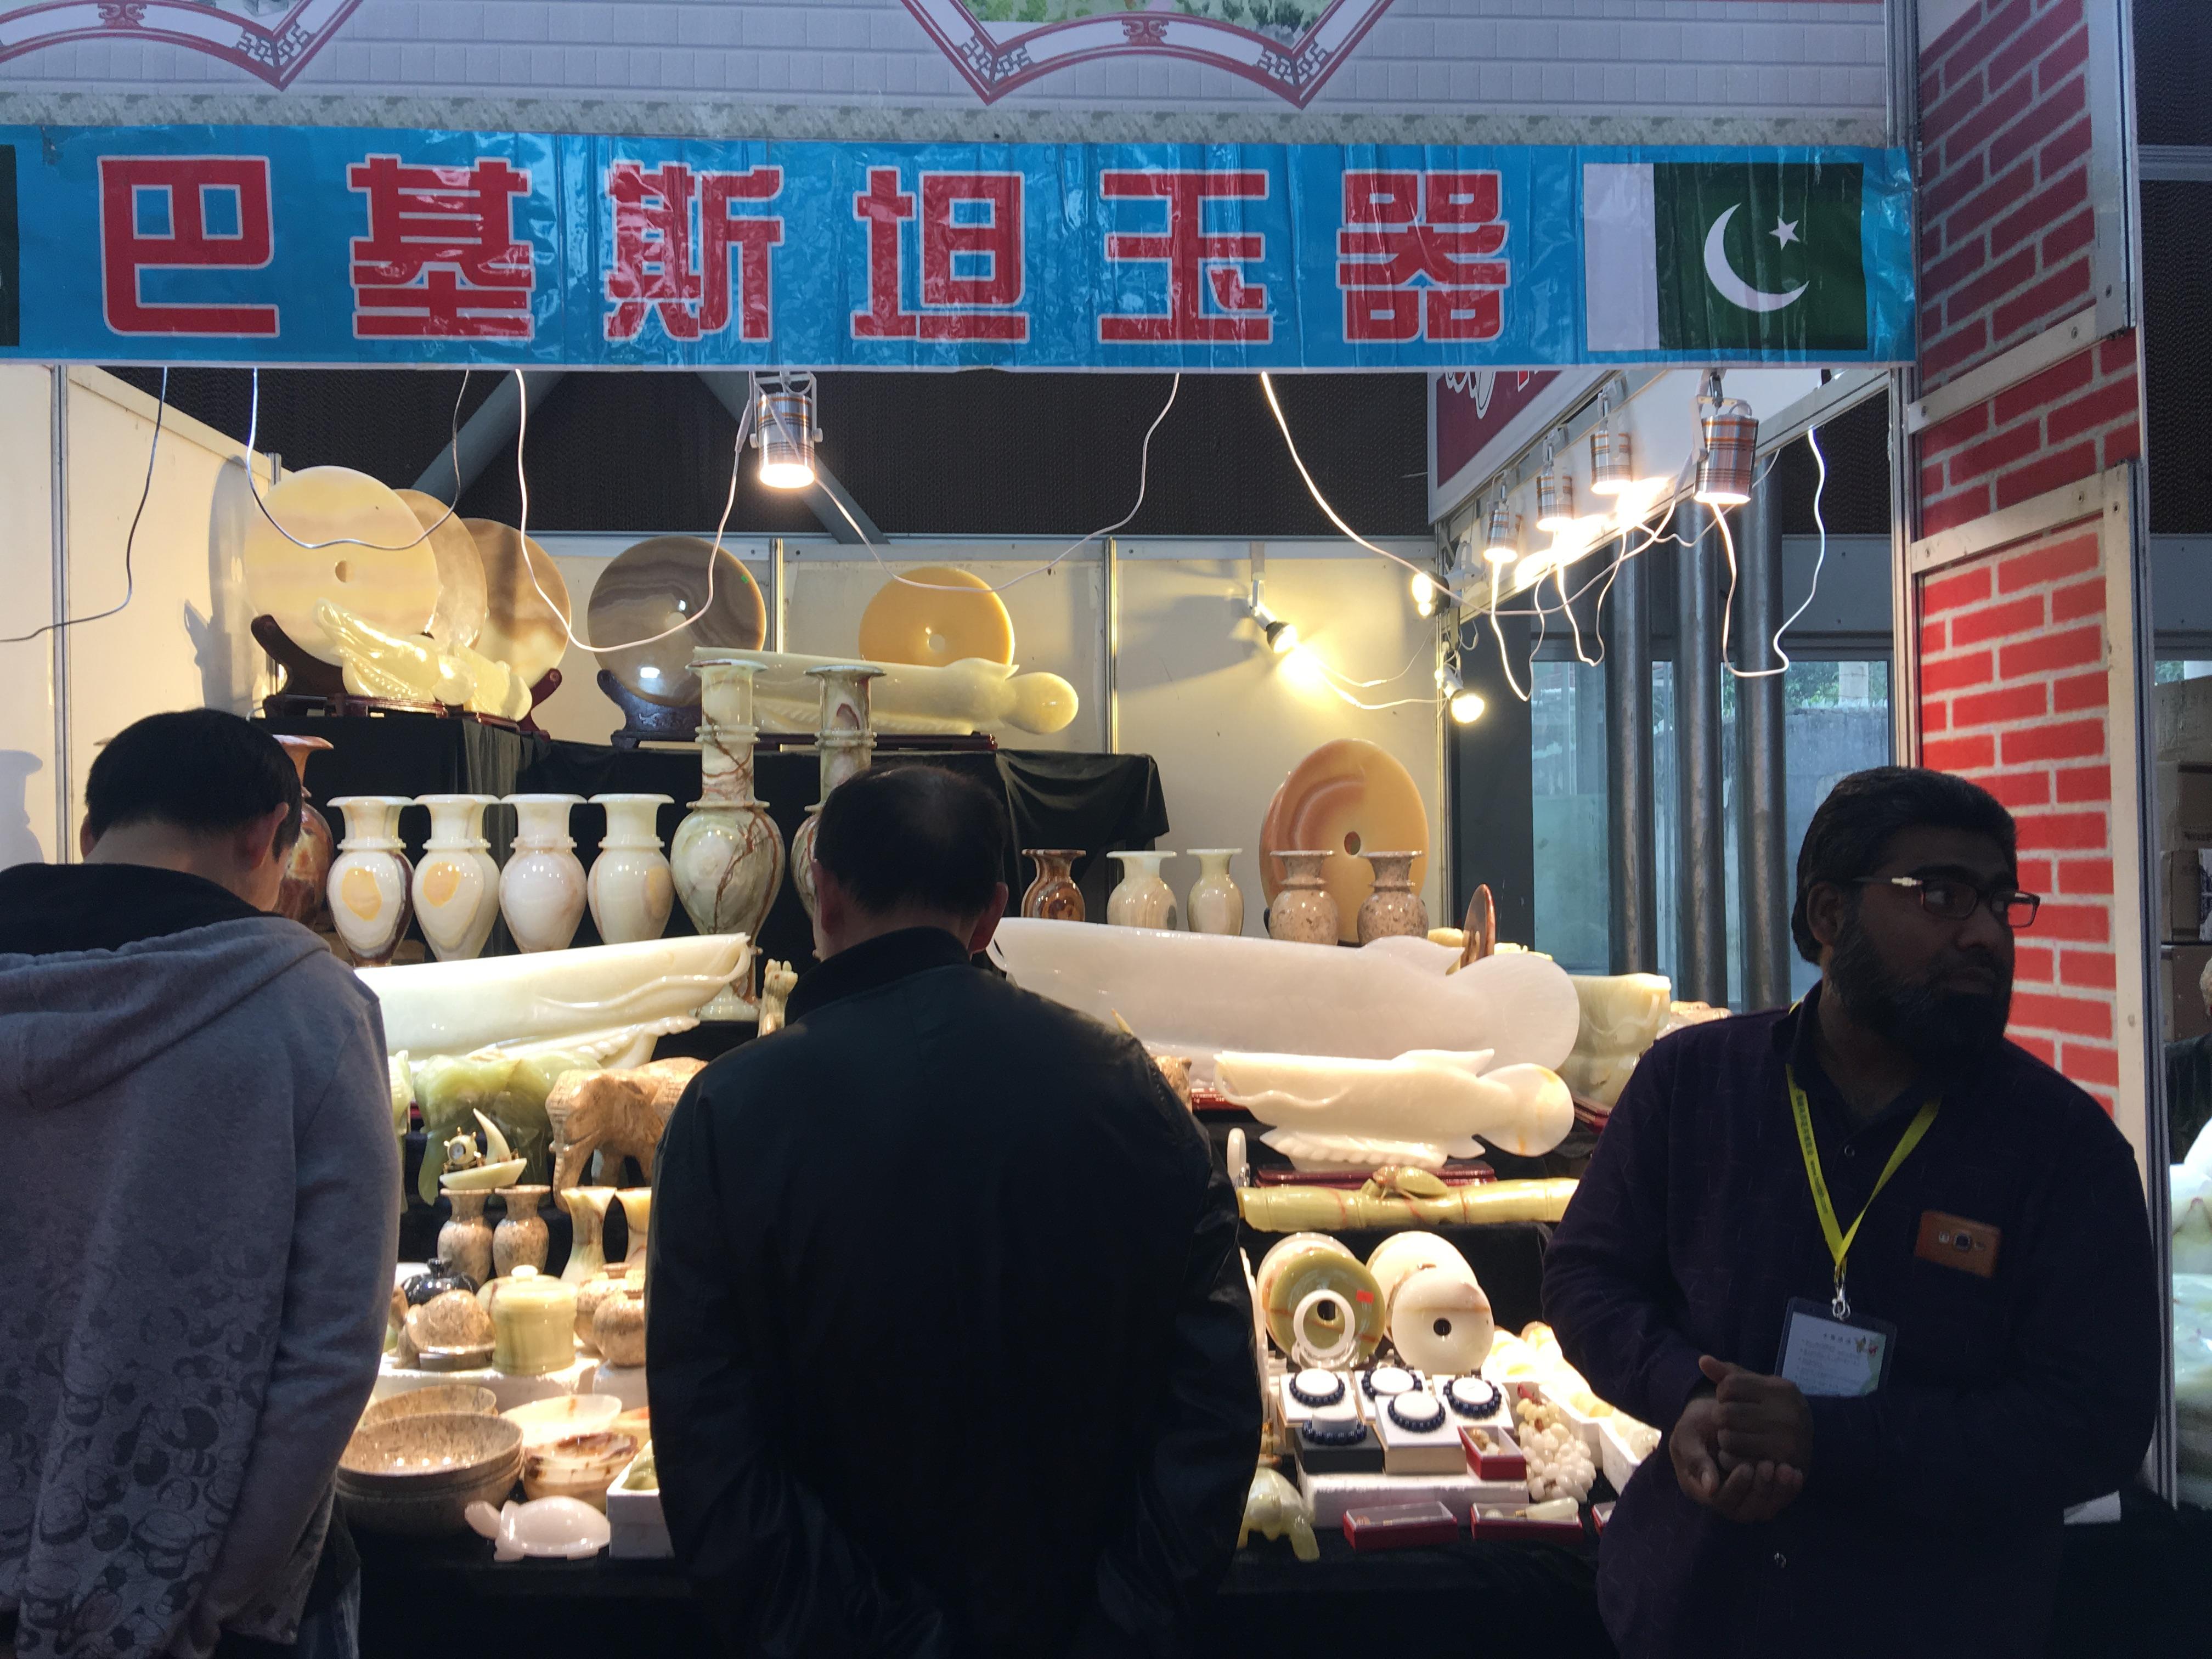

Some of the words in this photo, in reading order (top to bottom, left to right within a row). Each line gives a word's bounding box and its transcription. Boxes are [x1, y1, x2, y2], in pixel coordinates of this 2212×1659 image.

[98, 154, 1511, 345] 巴基斯坦玉器
